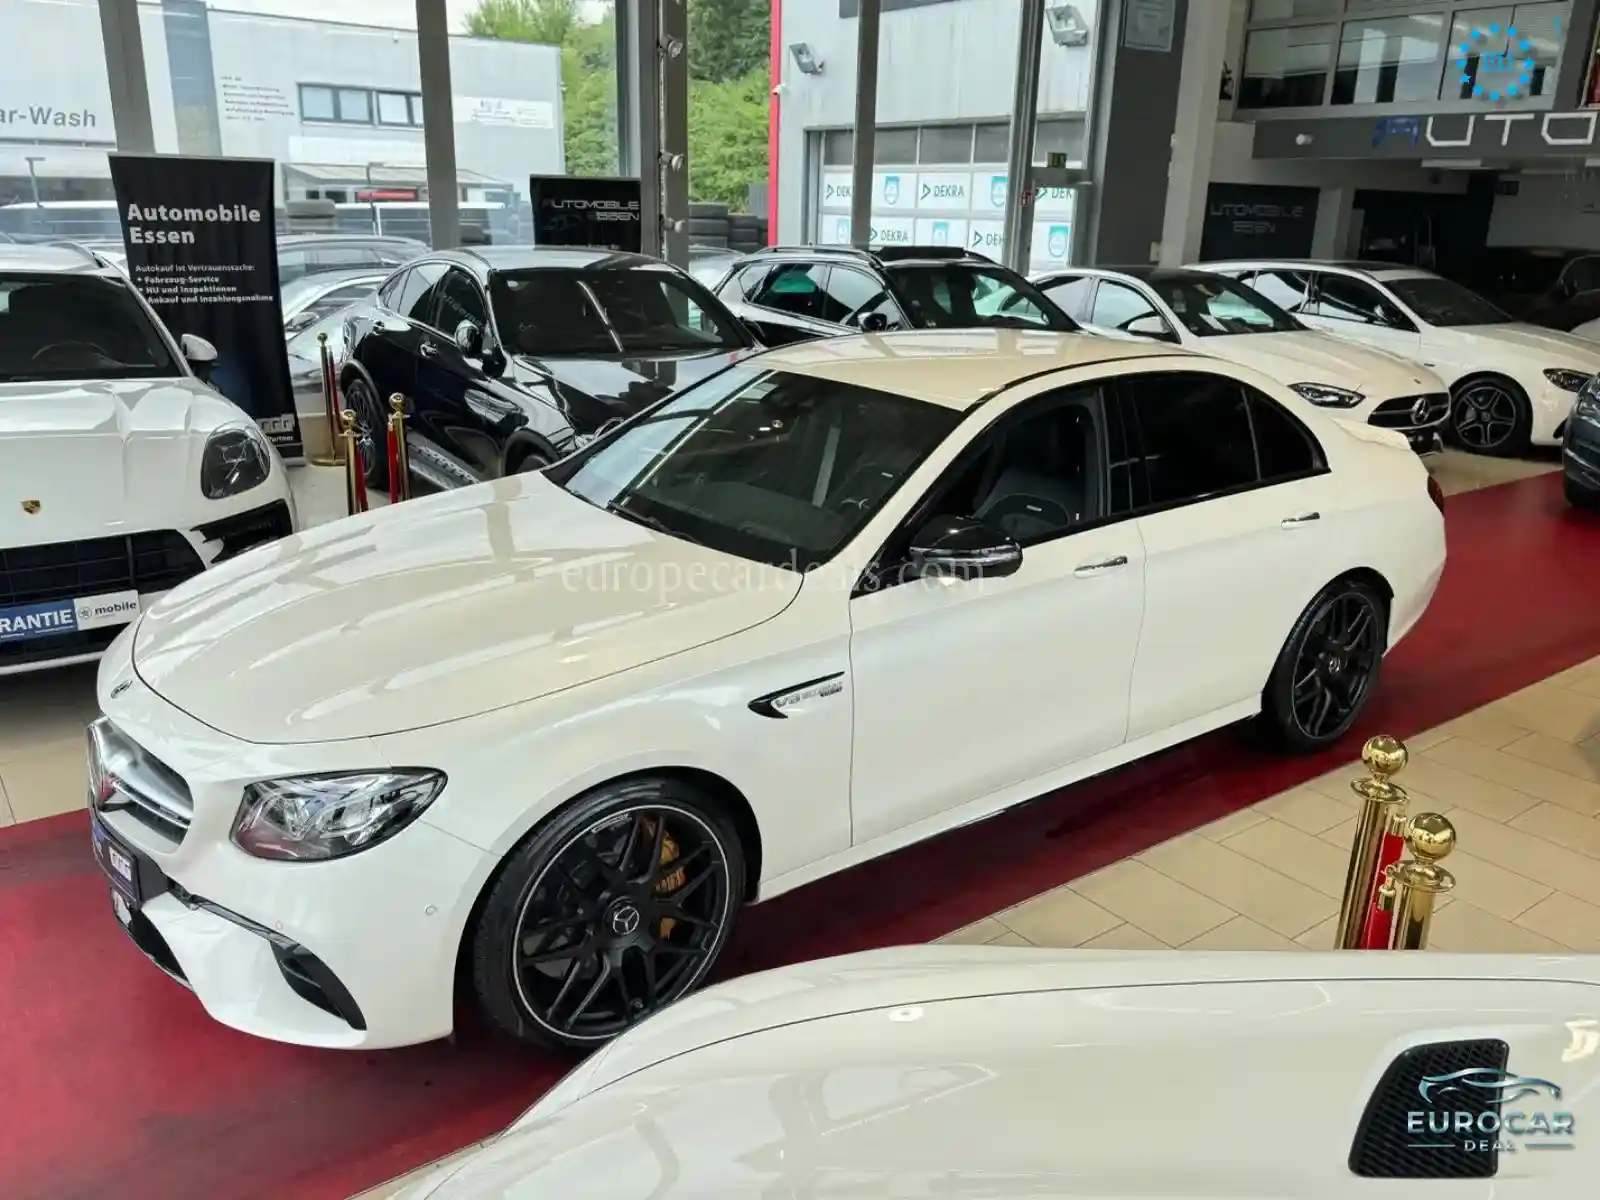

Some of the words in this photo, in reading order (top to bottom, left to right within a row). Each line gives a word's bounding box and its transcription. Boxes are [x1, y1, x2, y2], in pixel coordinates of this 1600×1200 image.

[0, 106, 96, 127] ar-Wash
[836, 186, 852, 197] DEK
[933, 184, 964, 197] DEKRA
[1051, 188, 1072, 199] DEK
[127, 203, 261, 223] Automobile
[129, 226, 195, 244] Essen
[880, 230, 908, 242] DEKRA
[135, 264, 174, 273] Autokauf
[144, 275, 220, 285] Fahrzeug-Service
[162, 285, 179, 293] und
[94, 600, 137, 615] mobile
[0, 608, 74, 633] RANTIE
